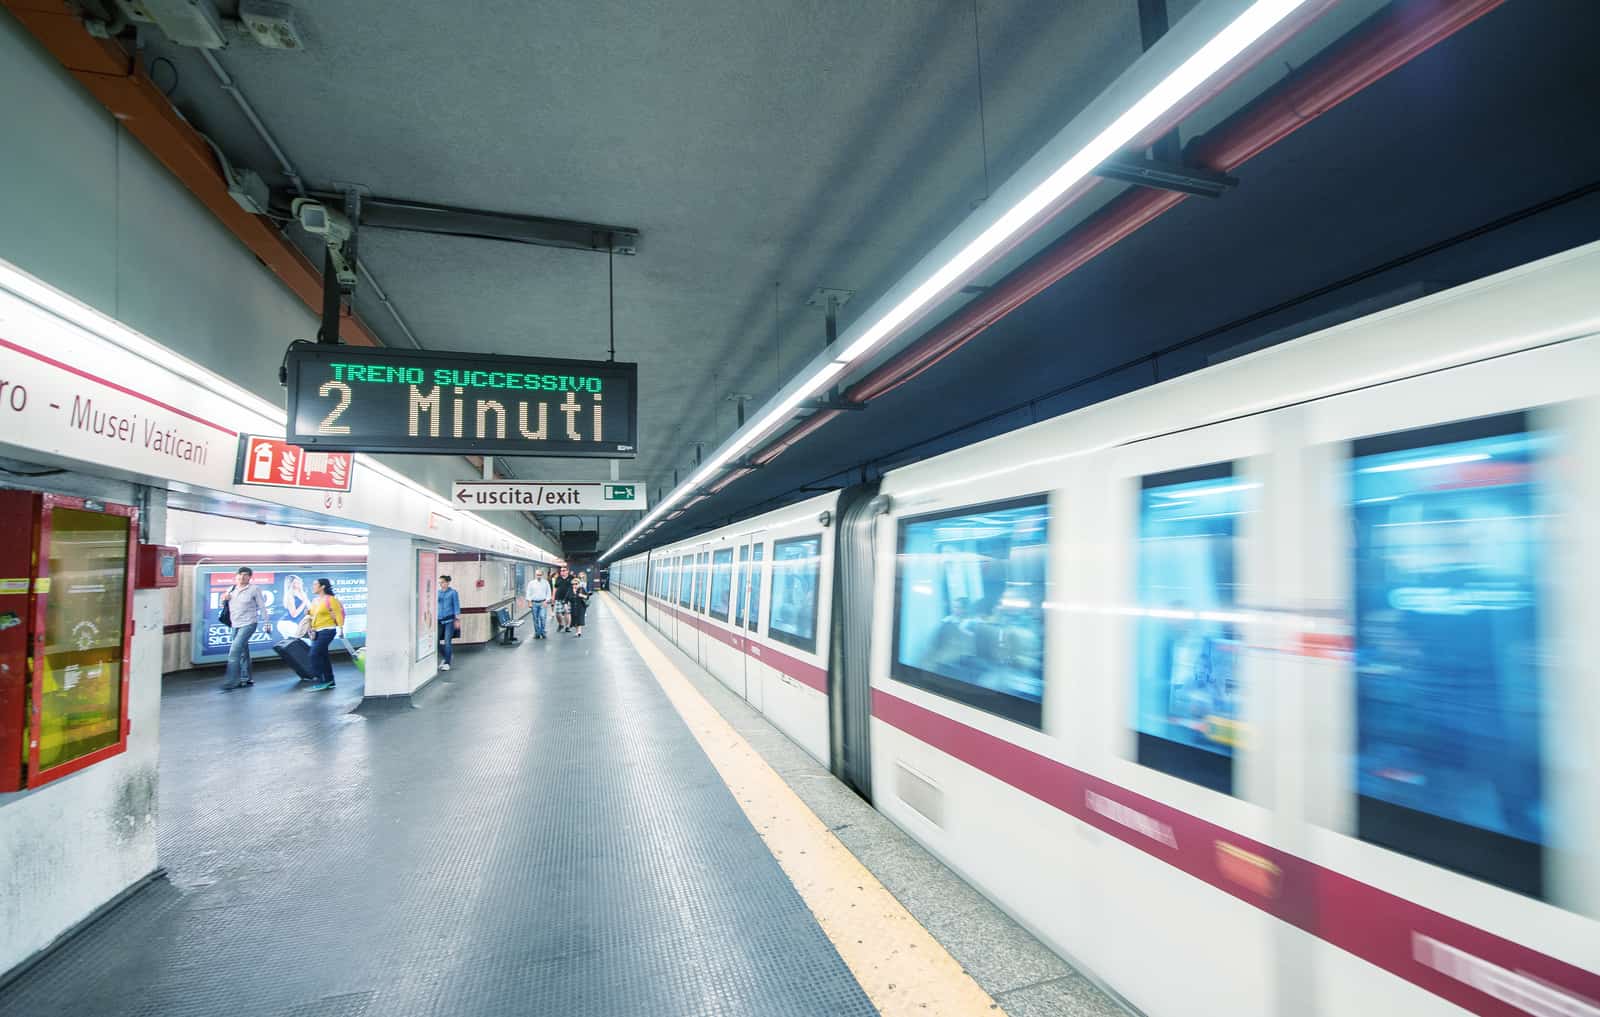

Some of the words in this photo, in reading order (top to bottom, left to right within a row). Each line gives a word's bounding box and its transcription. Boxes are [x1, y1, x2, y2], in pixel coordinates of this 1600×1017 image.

[329, 363, 425, 384] TRENO
[433, 369, 603, 393] SUCCESSIVO
[69, 394, 137, 444] Musei
[143, 417, 209, 466] Vaticani
[319, 380, 352, 434] 2
[408, 384, 602, 442] Minuti
[476, 485, 581, 506] uscita/exit
